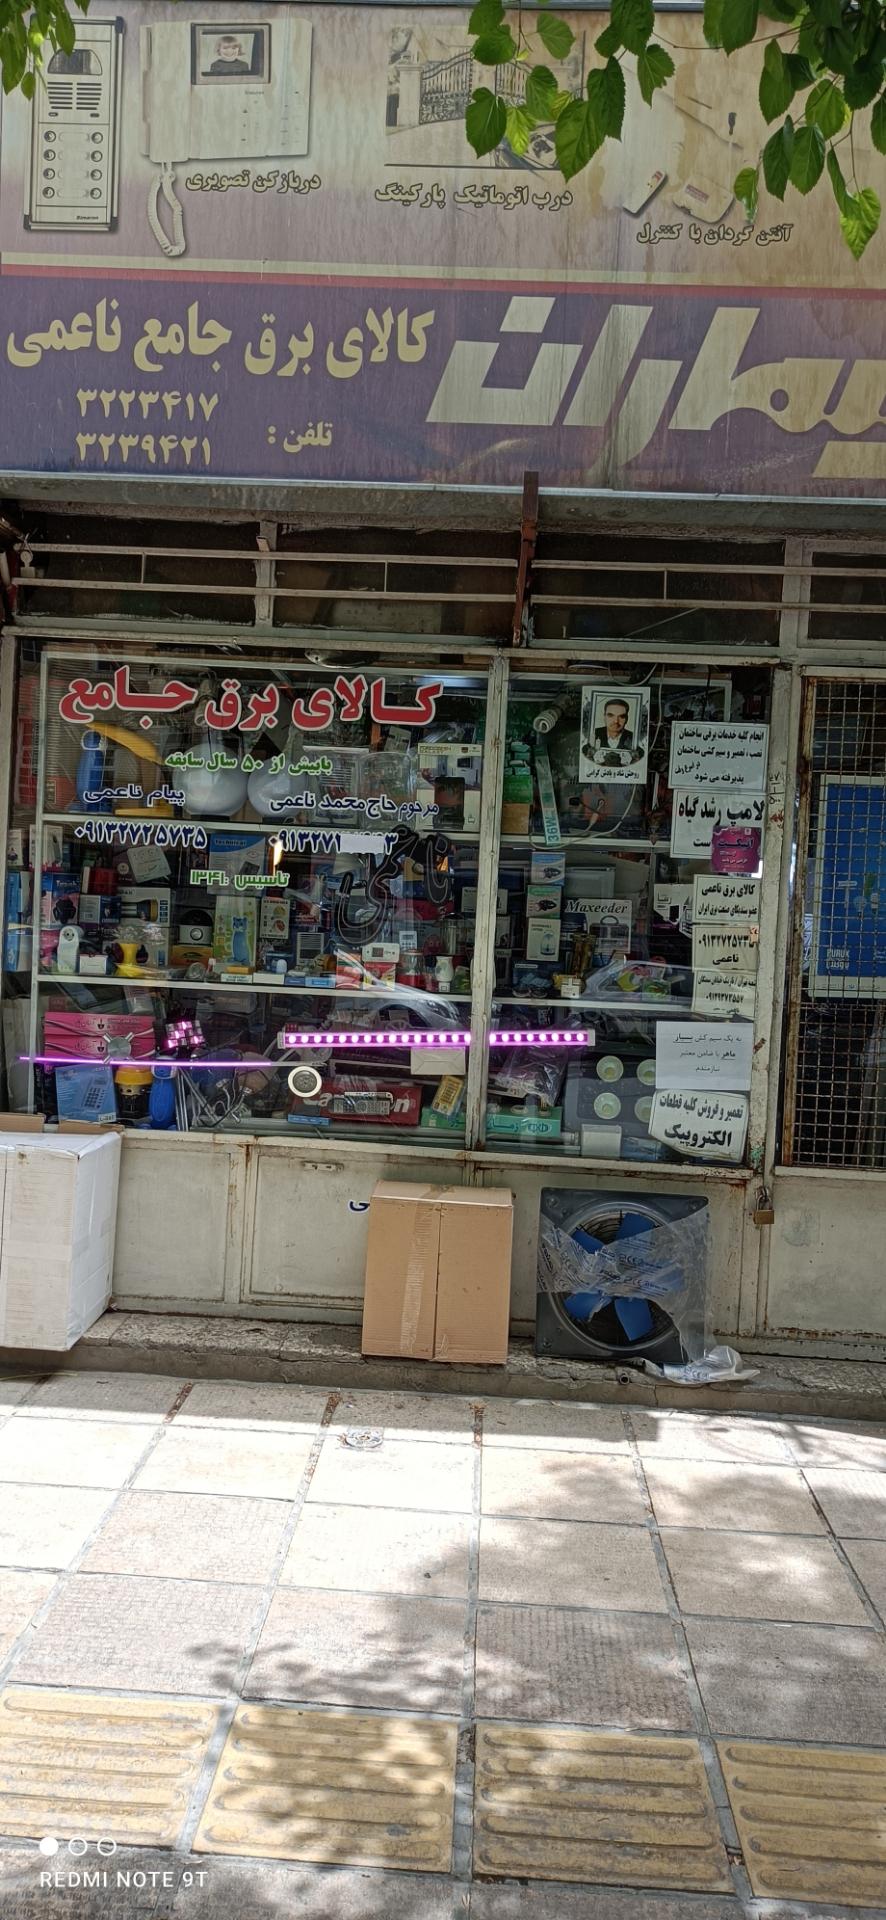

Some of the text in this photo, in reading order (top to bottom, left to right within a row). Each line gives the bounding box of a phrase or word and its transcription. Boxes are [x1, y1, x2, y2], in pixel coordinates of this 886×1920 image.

[185, 170, 251, 192] تصویری
[375, 183, 573, 211] درب اتوماتیک پارکینگ
[636, 222, 683, 244] کنترل
[688, 223, 701, 245] با
[755, 223, 794, 246] آنتن
[6, 297, 436, 379] کالای برق جامع ناعمی
[76, 388, 219, 422] ۳۲۲۳۴۱۷
[283, 420, 333, 453] تلفن
[75, 433, 212, 466] ۳۲۳۹۴۲۱
[59, 665, 444, 732] کالای برق جامع
[679, 728, 702, 740] ساختمان
[703, 728, 717, 741] برقی
[717, 729, 737, 740] خدمات
[749, 731, 764, 743] انجام
[165, 752, 204, 771] سابقه
[206, 752, 237, 771] سال
[677, 746, 700, 756] ساختمان
[241, 754, 264, 772] ۵۰
[268, 754, 285, 774] از
[694, 773, 708, 783] شود
[721, 773, 744, 784] پذیرفته
[83, 783, 186, 807] پیام ناعمی
[270, 791, 439, 822] مرحوم حاج محمد ناعمی
[678, 795, 765, 827] لامپ رشد گیاه
[235, 871, 290, 890] تاسیس
[702, 883, 756, 898] کالای برق ناعمی
[565, 900, 628, 914] Maxeeder
[712, 954, 739, 965] ناعمی
[660, 1093, 744, 1121] تعمیر و فروش کلیه قطعات
[664, 1123, 732, 1148] الکتروپیک
